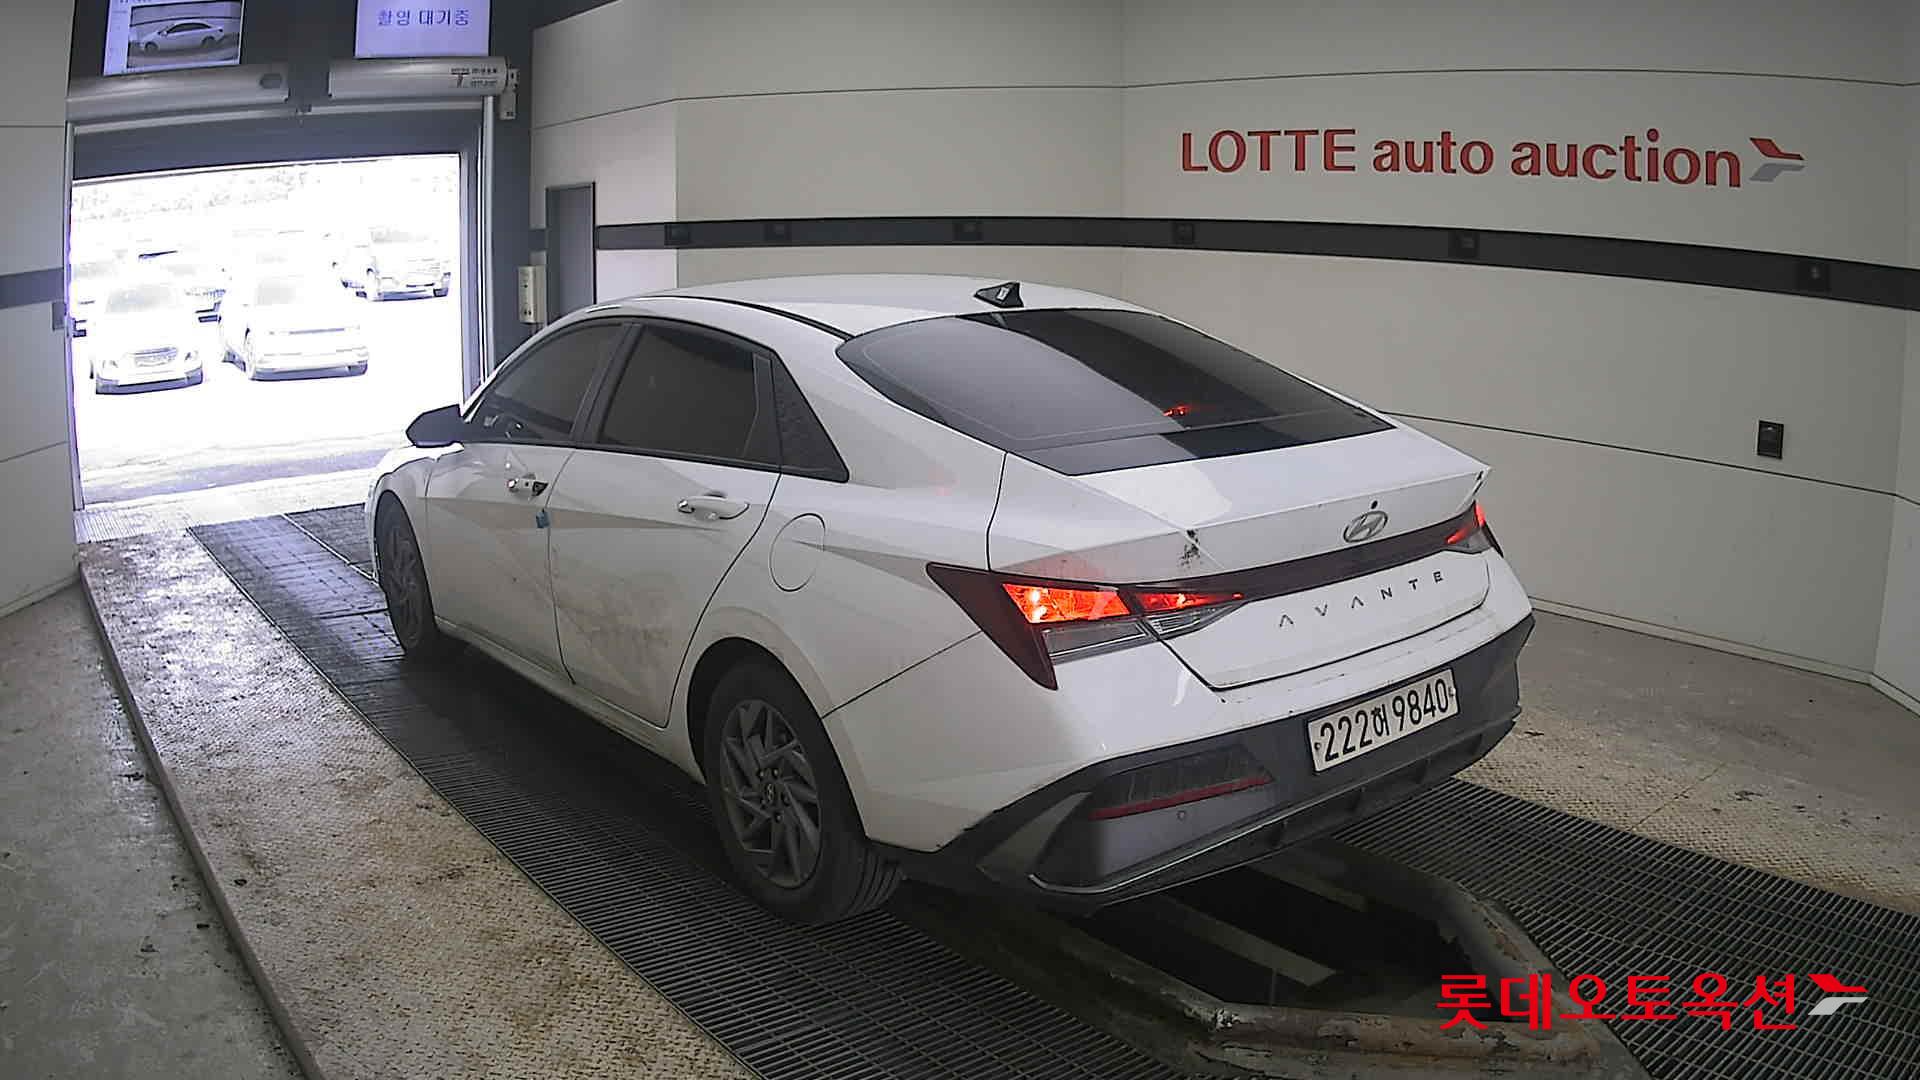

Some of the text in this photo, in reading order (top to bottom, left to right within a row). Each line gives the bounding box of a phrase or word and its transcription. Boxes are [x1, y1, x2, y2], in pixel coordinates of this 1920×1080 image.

[419, 9, 470, 26] 대기중
[1182, 128, 1741, 188] LOTTE auto auction
[1279, 571, 1444, 628] AVANTE
